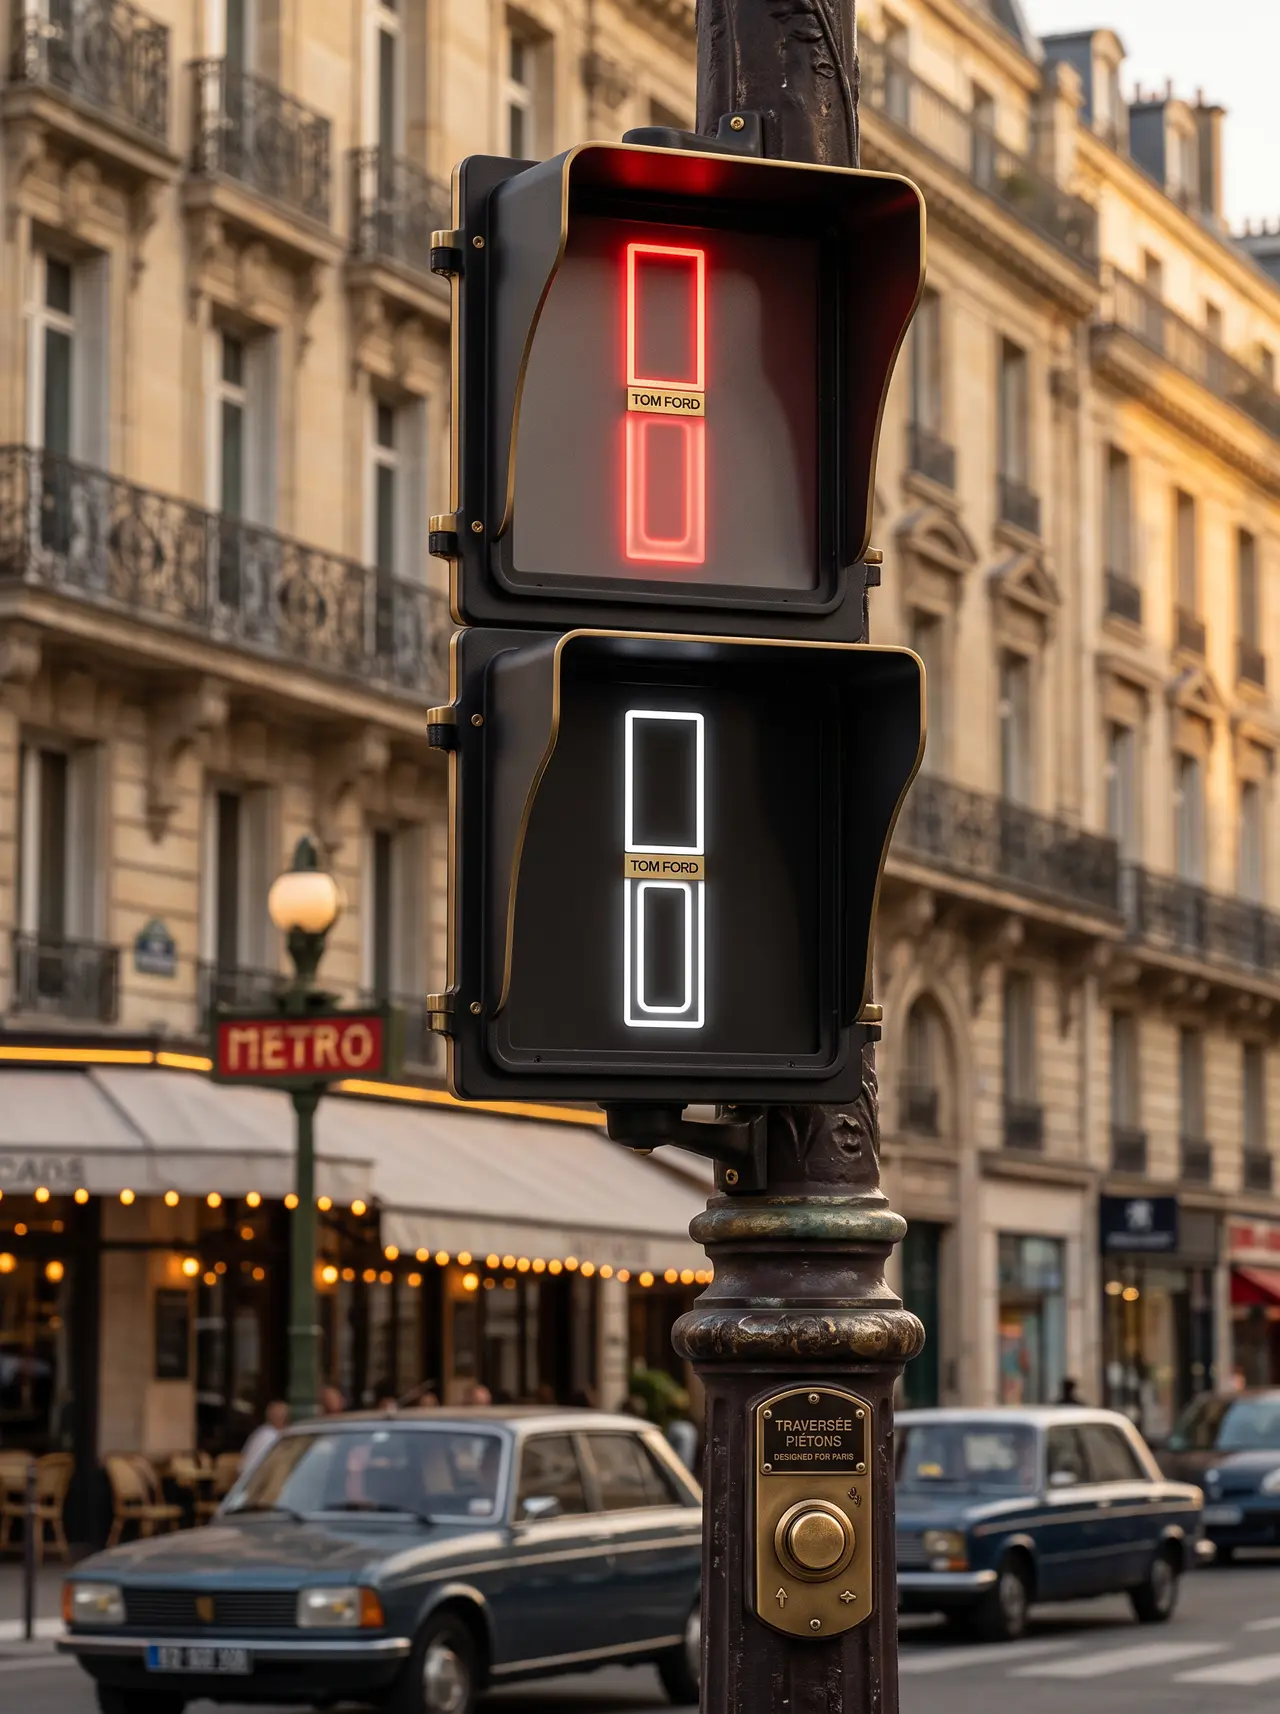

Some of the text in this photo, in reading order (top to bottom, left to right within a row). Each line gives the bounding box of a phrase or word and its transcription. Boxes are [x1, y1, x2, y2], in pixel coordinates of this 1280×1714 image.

[632, 394, 700, 410] TOM FORD
[630, 860, 699, 873] TOM FORD
[227, 1023, 374, 1071] METRO
[775, 1417, 852, 1432] TRAVERSÉE
[786, 1432, 842, 1447] PIÉTONS
[773, 1453, 854, 1461] DESIGNED FOR PARIS
